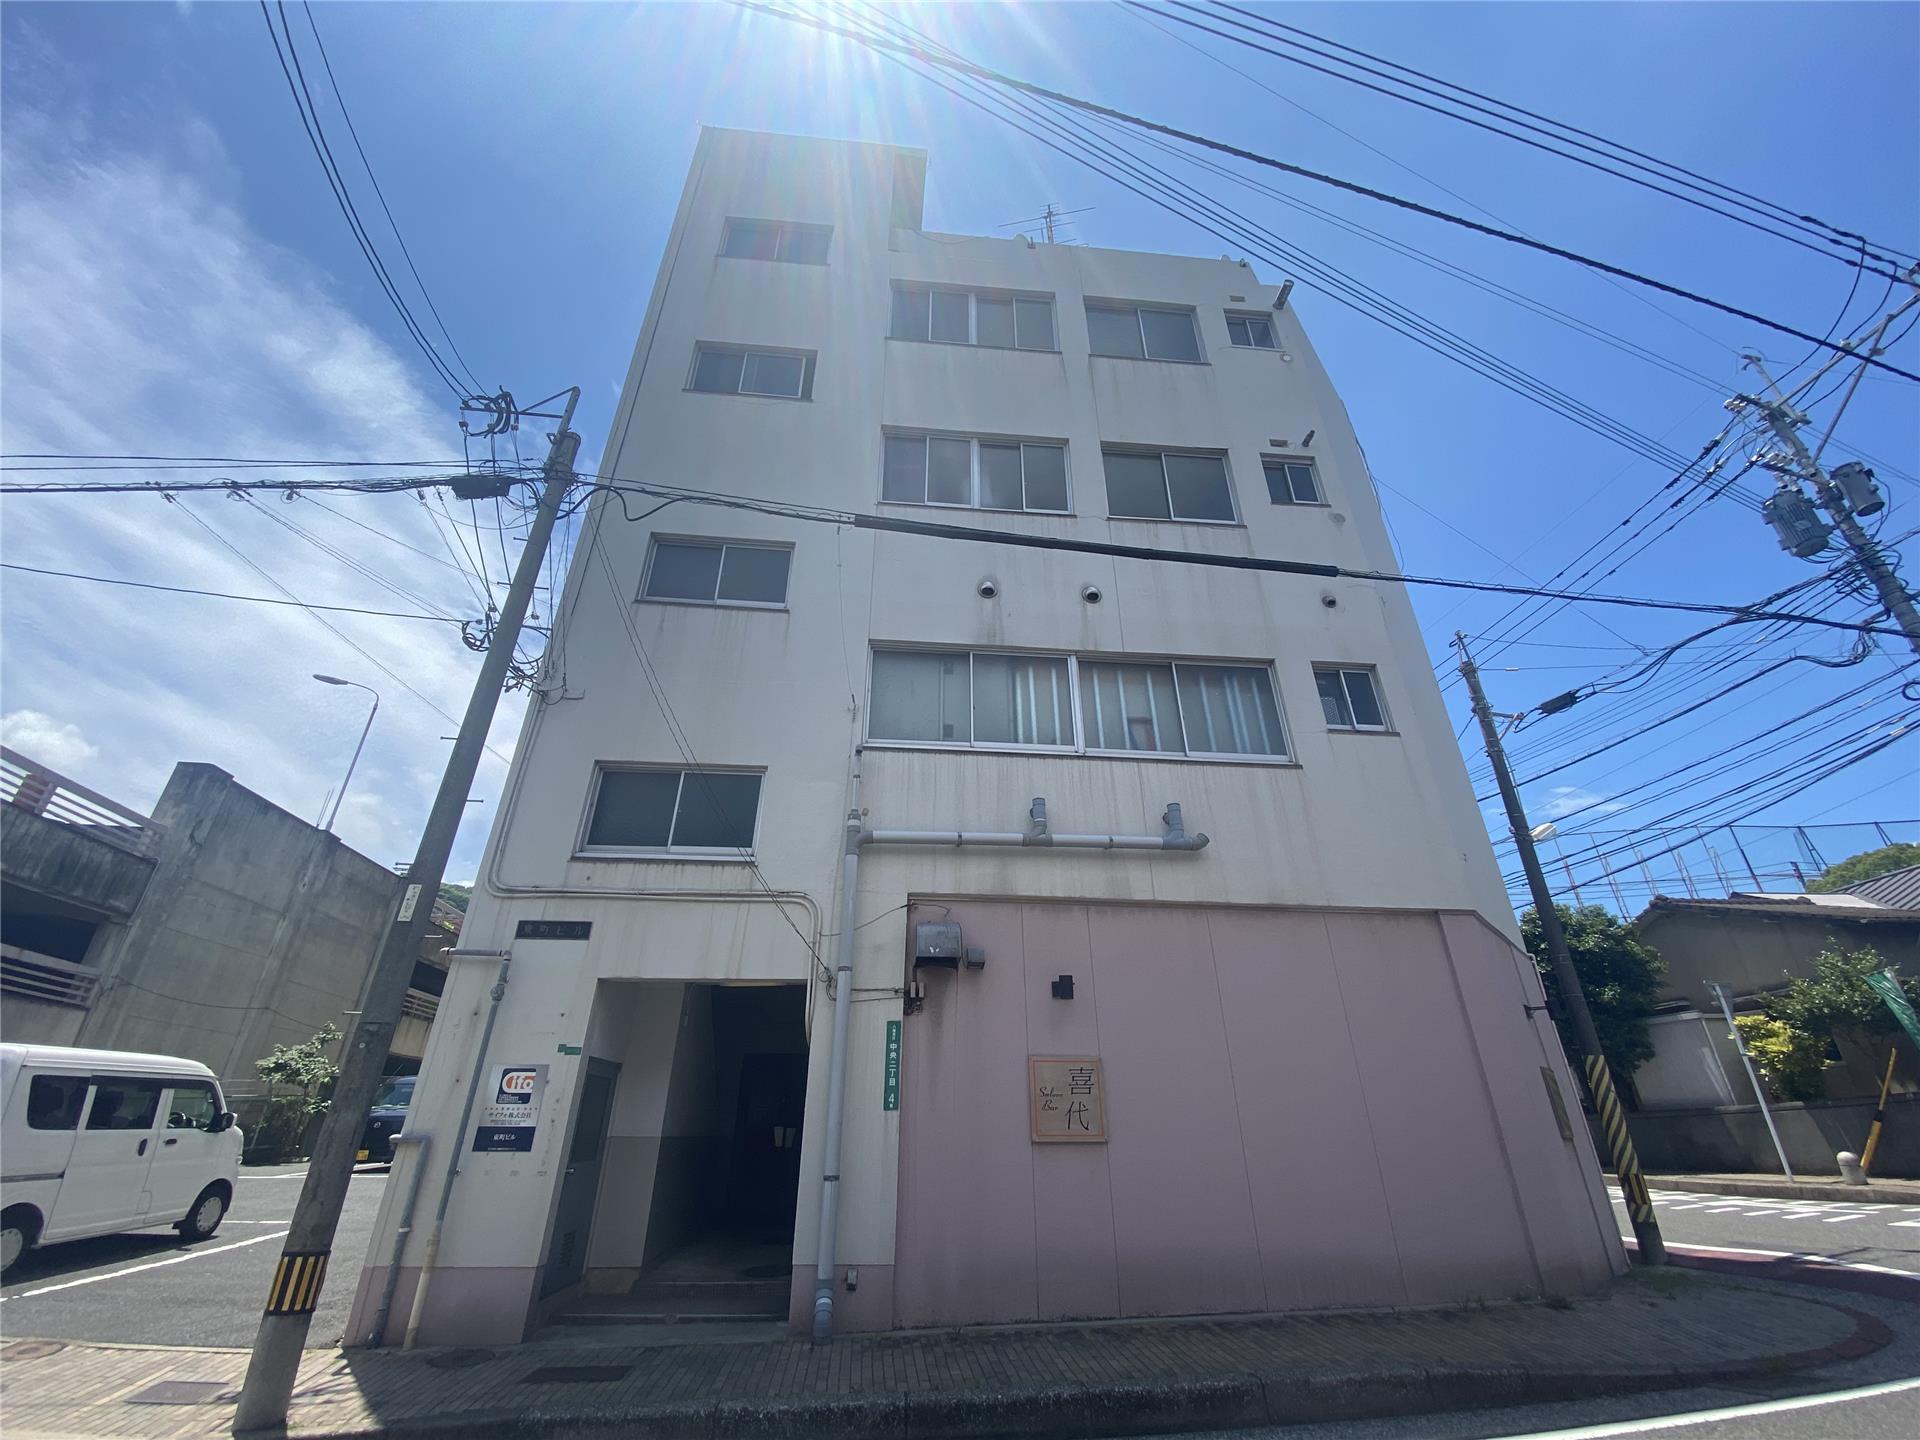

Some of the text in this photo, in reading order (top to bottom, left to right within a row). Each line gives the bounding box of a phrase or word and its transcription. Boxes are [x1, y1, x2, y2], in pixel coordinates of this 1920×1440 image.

[889, 1043, 898, 1086] 中央二丁目
[1065, 1066, 1095, 1131] 喜代
